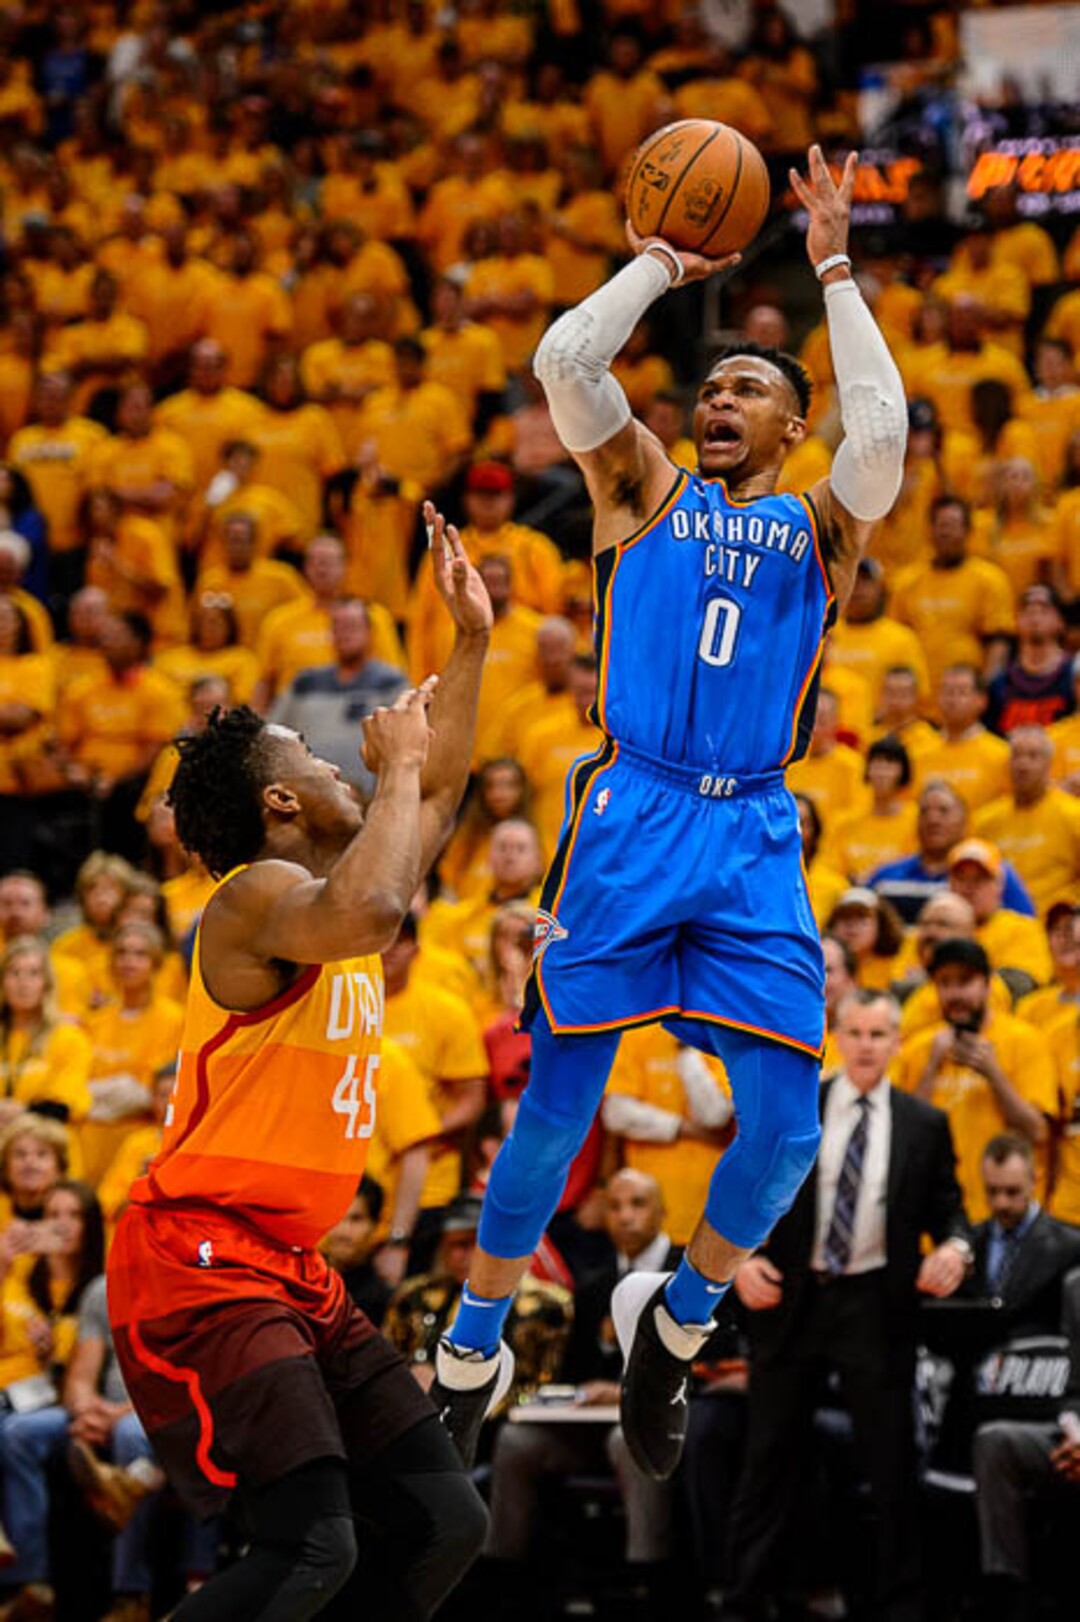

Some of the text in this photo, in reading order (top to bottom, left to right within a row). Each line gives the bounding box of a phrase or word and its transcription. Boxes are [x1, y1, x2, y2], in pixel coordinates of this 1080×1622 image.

[671, 509, 810, 562] OKAHOMA
[705, 543, 760, 588] CITY
[699, 597, 741, 667] 0
[326, 972, 385, 1040] UTA
[332, 1054, 380, 1139] 45
[999, 1353, 1071, 1397] PLAYO
